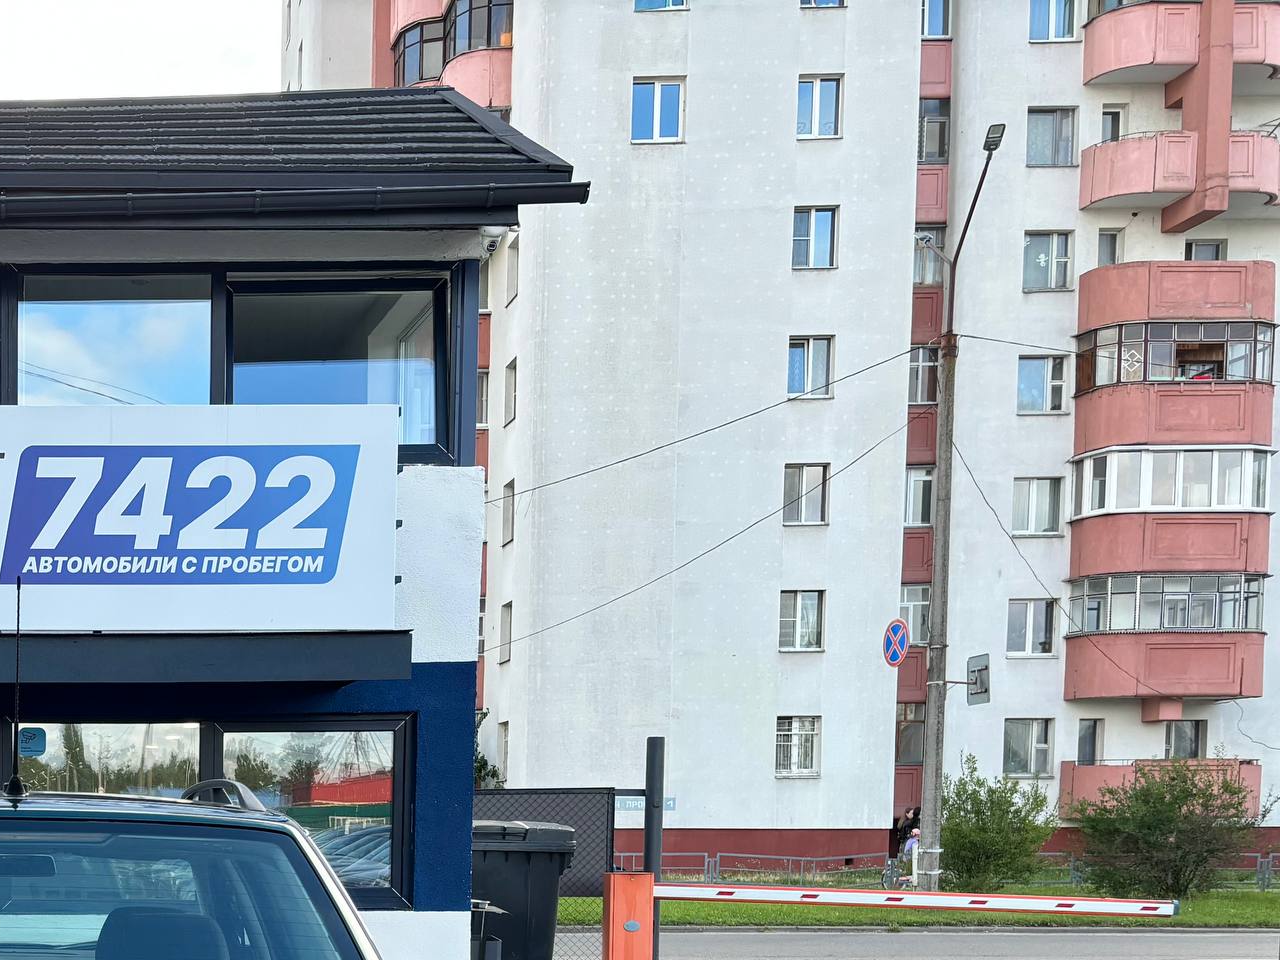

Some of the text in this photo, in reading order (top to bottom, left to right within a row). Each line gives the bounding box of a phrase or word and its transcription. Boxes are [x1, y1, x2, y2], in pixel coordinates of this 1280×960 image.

[30, 455, 336, 550] 7422
[22, 555, 324, 574] АВТОМОБИЛИ С ПРОБЕГОМ
